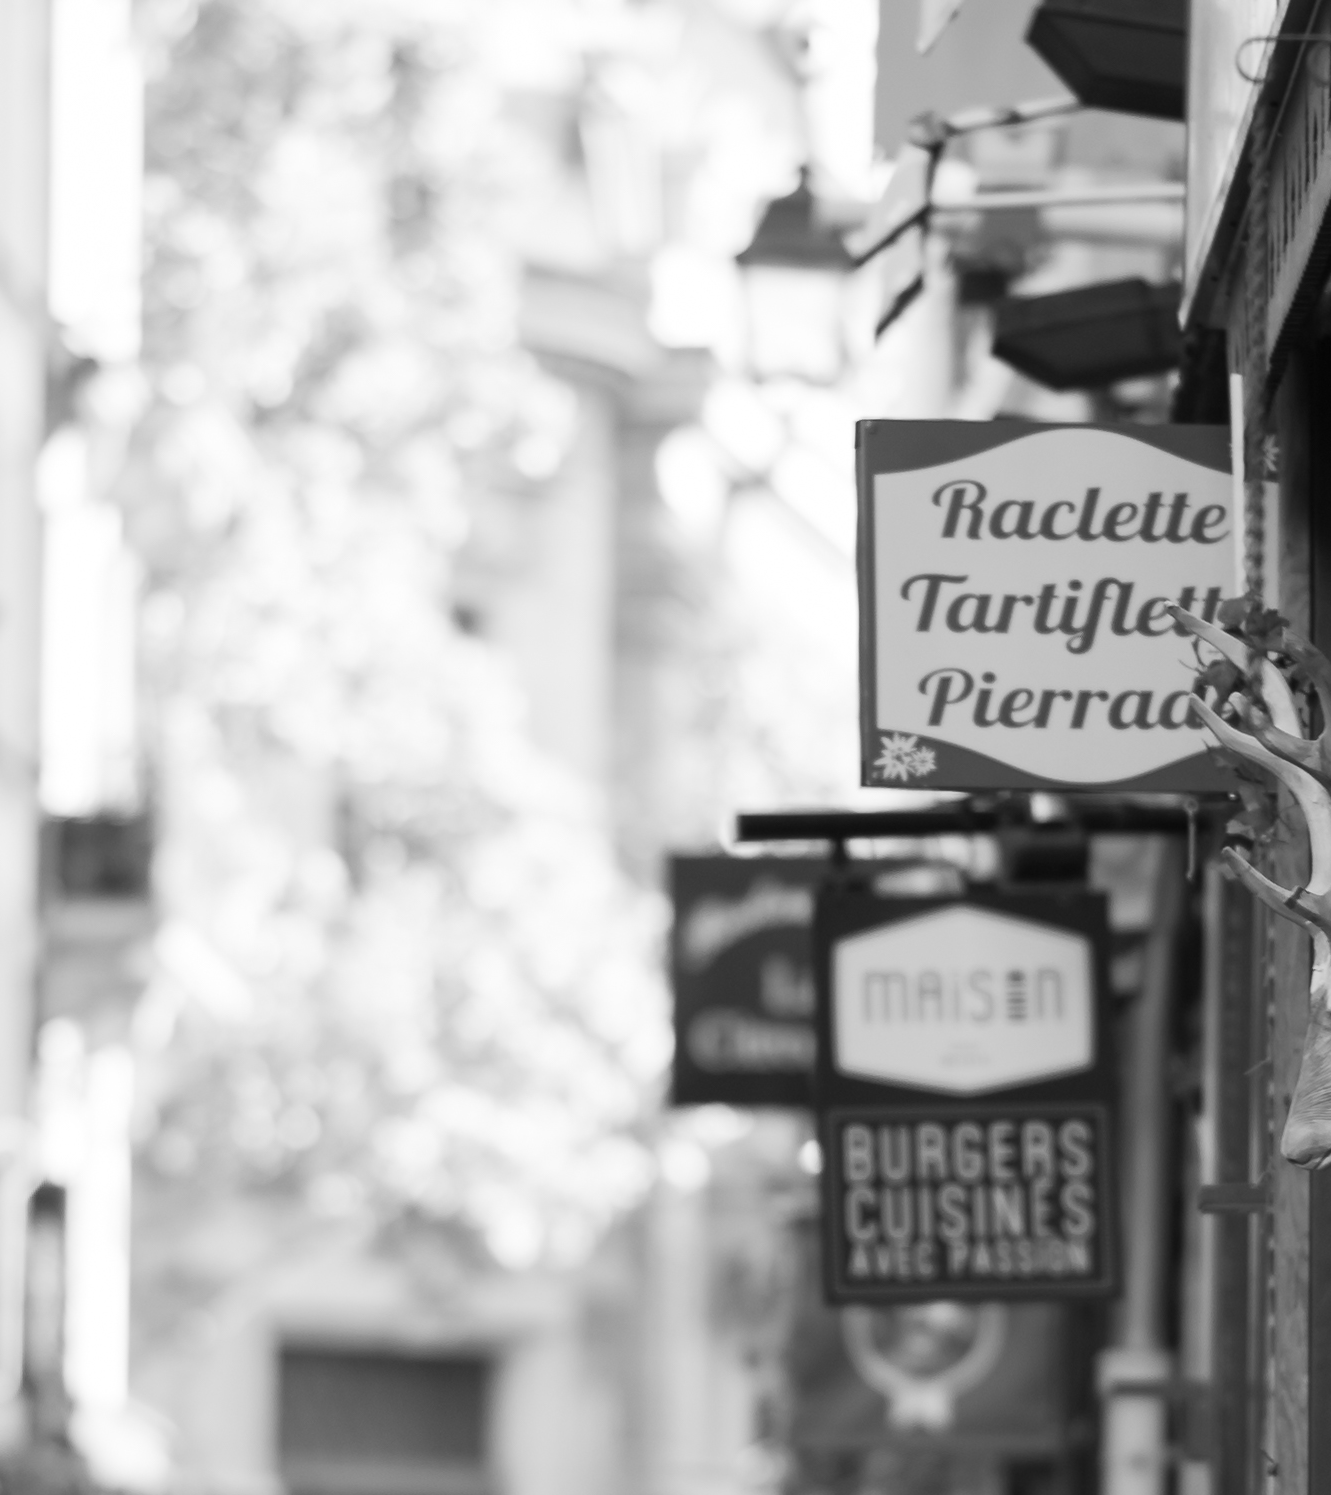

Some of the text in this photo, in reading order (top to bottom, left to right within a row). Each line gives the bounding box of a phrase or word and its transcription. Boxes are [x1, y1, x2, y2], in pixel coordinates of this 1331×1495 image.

[932, 479, 1230, 544] Raclette
[899, 575, 1223, 654] Tartiflett
[917, 667, 1212, 731] Pierrad
[842, 1121, 1093, 1181] BURGERS
[844, 1181, 1094, 1241] CUISINES
[848, 1238, 1091, 1276] AVEC PASSION
